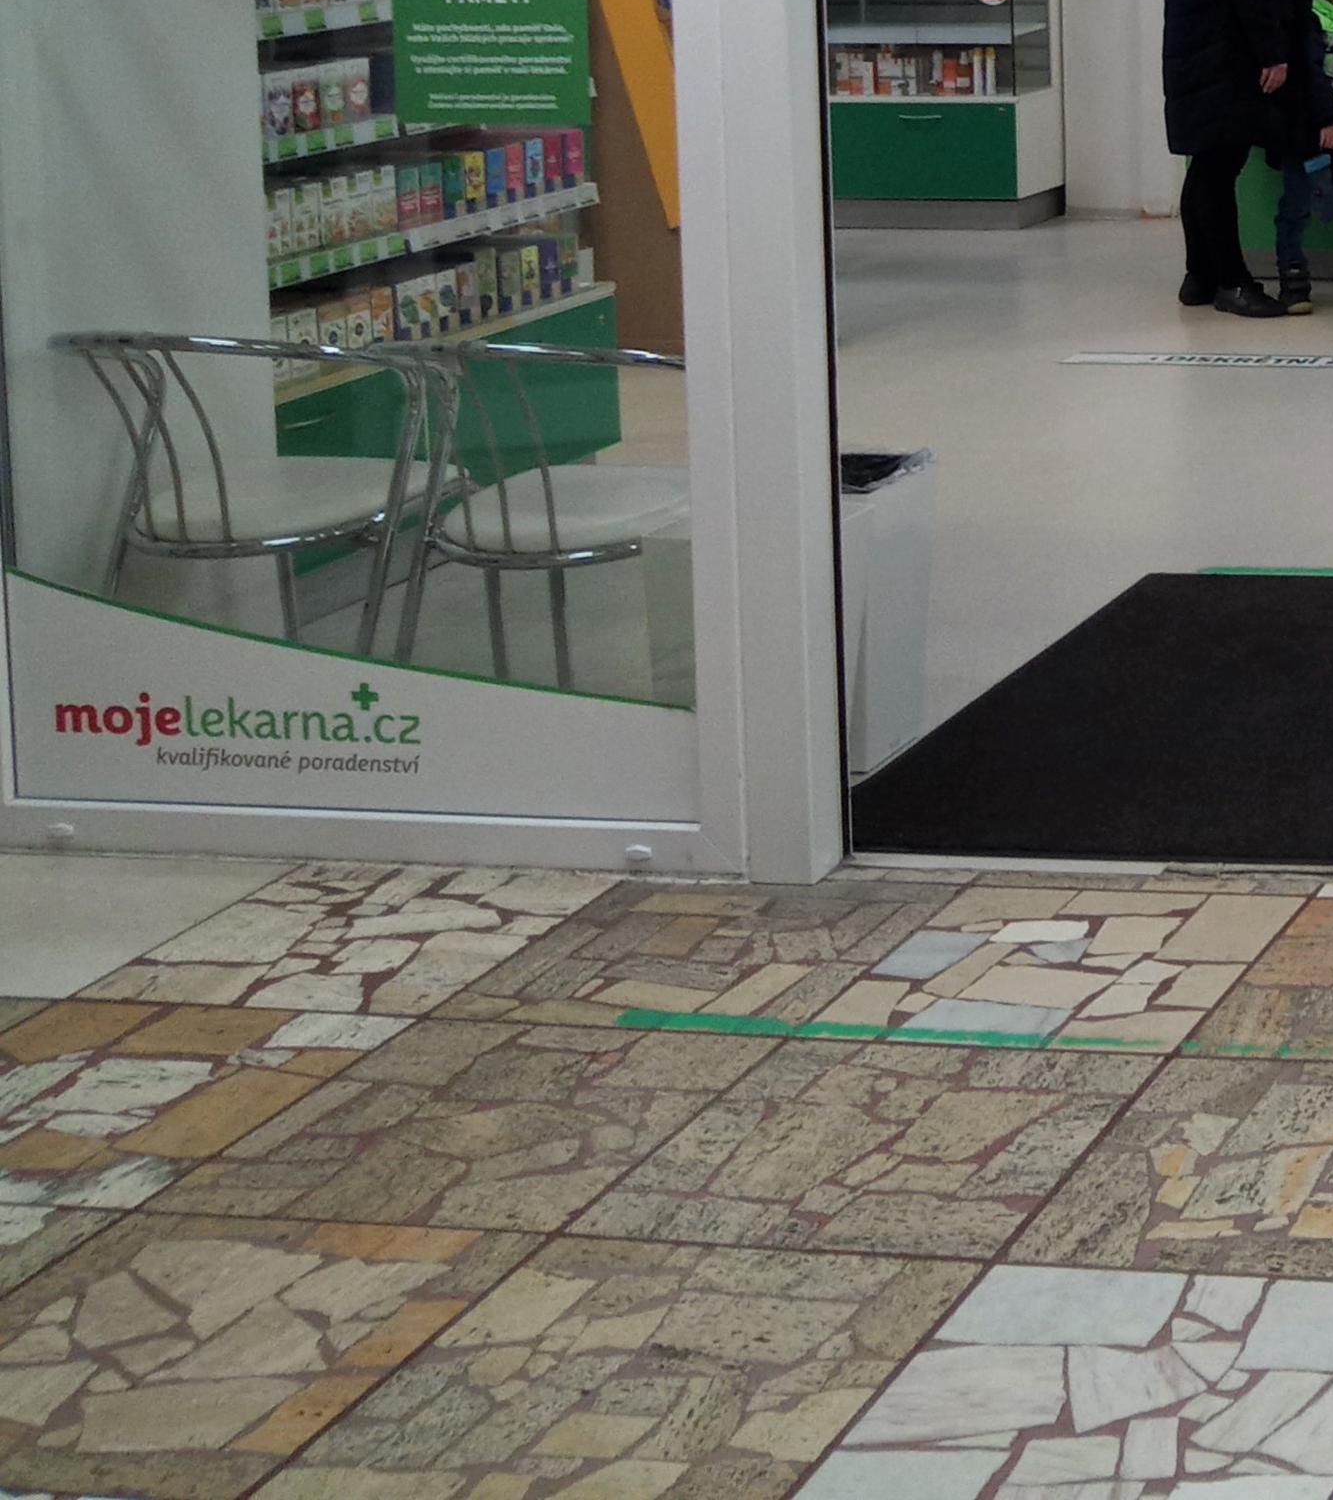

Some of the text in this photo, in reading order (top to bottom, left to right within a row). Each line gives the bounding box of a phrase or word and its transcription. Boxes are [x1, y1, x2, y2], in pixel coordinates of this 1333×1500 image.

[55, 692, 422, 746] mojelekarna.cz
[156, 746, 421, 775] kvalifikované poradenství
